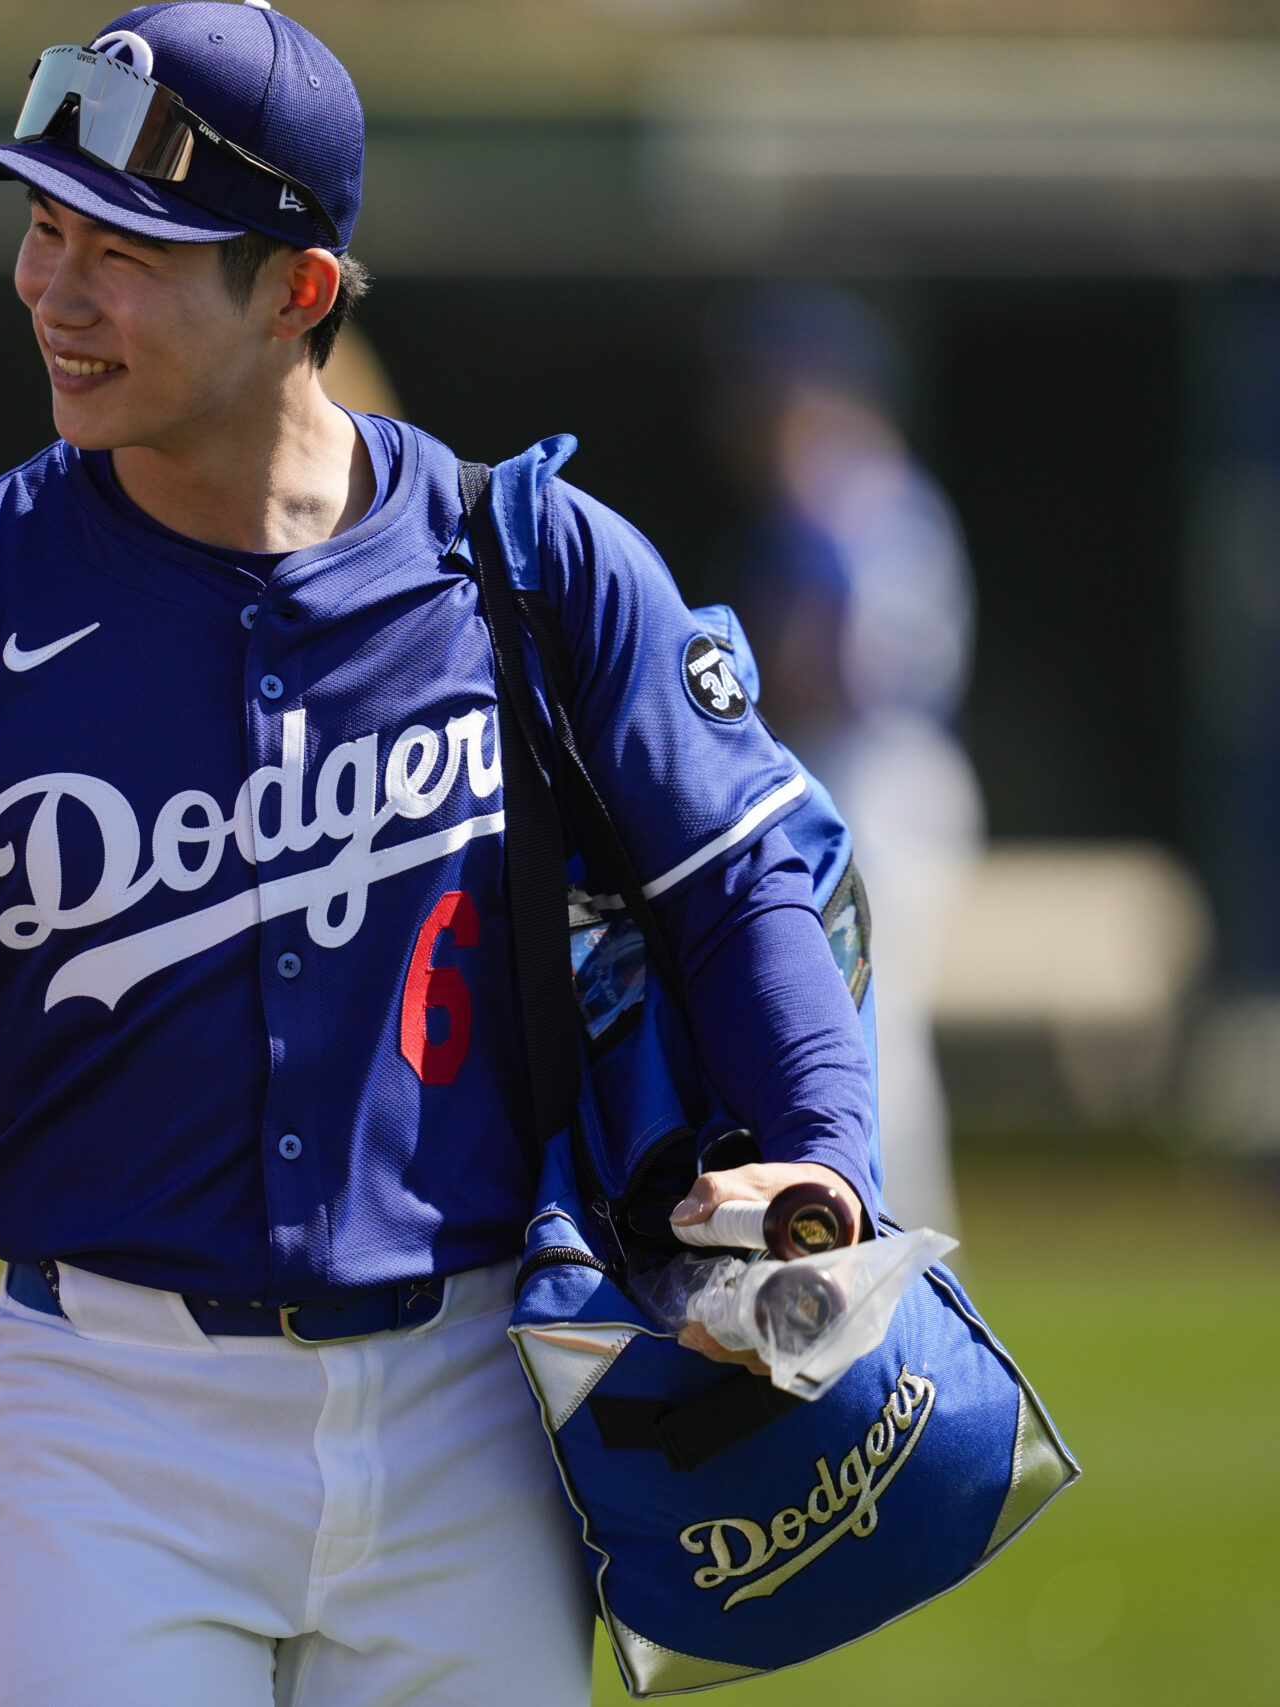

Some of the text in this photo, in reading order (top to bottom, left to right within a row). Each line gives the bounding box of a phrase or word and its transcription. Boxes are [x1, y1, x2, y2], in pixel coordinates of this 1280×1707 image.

[76, 52, 98, 65] uvex
[199, 123, 221, 144] uvex
[701, 661, 744, 711] 34
[401, 890, 481, 1086] 6
[679, 1362, 935, 1595] Dodgers
